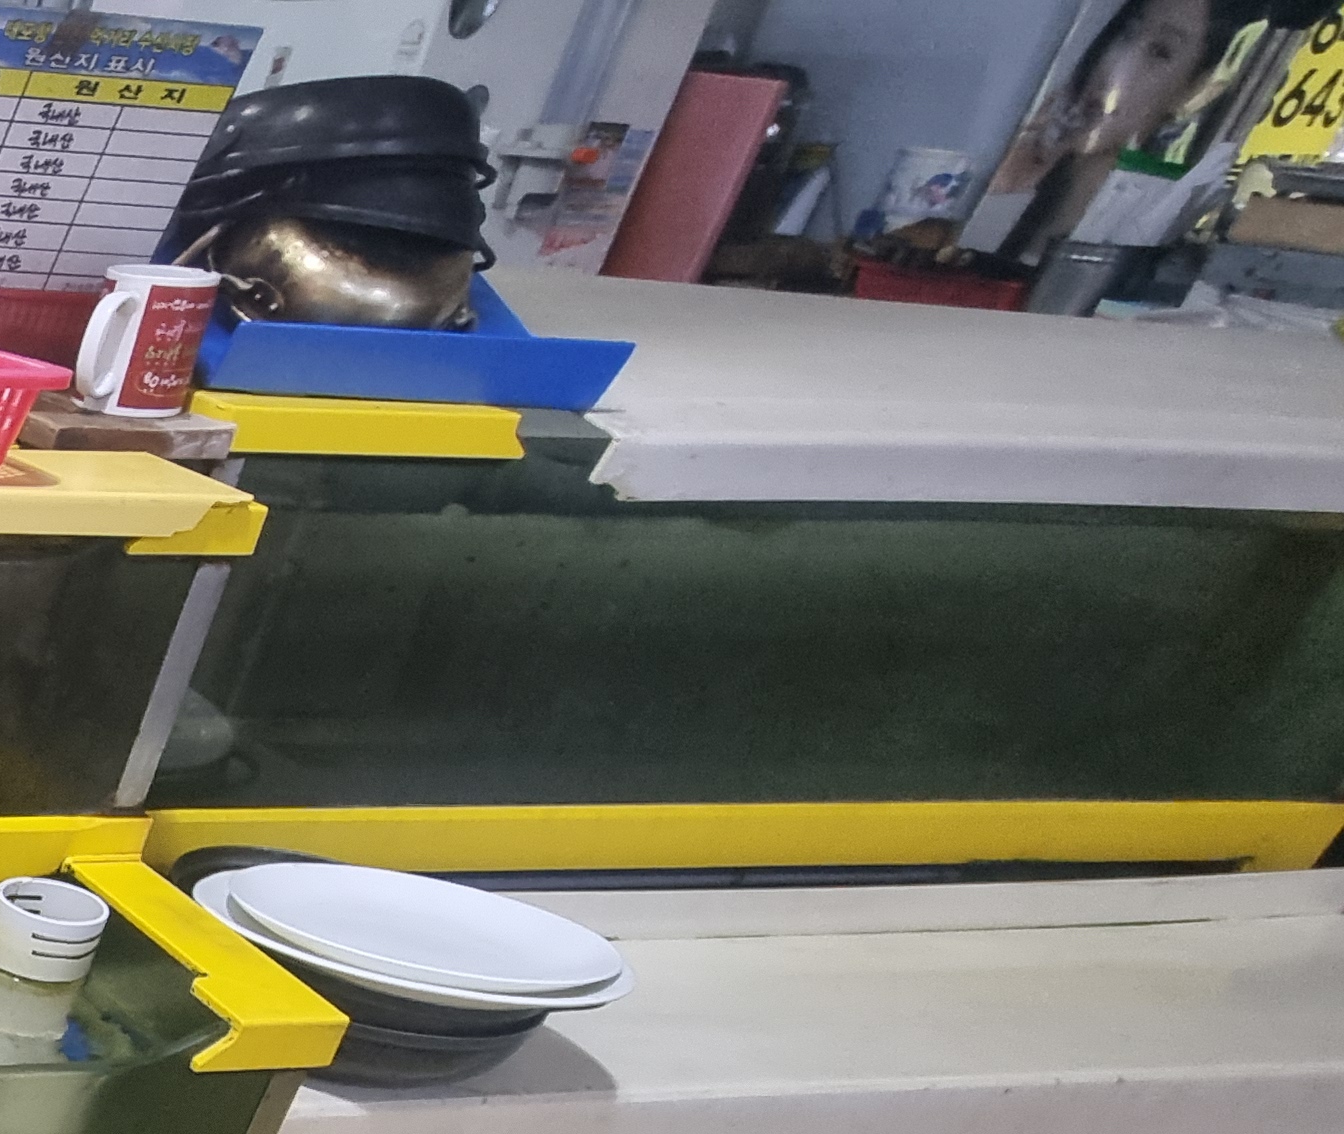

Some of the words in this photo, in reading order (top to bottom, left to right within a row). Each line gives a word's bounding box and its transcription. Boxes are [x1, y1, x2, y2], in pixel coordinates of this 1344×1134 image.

[24, 47, 98, 70] 원산지
[103, 55, 156, 76] 표시
[74, 79, 100, 97] 원
[118, 83, 144, 100] 산
[161, 87, 187, 104] 지
[38, 102, 82, 126] 국내산
[28, 129, 74, 150] 국내산
[19, 154, 65, 175] 국내산
[0, 201, 42, 220] 국내산
